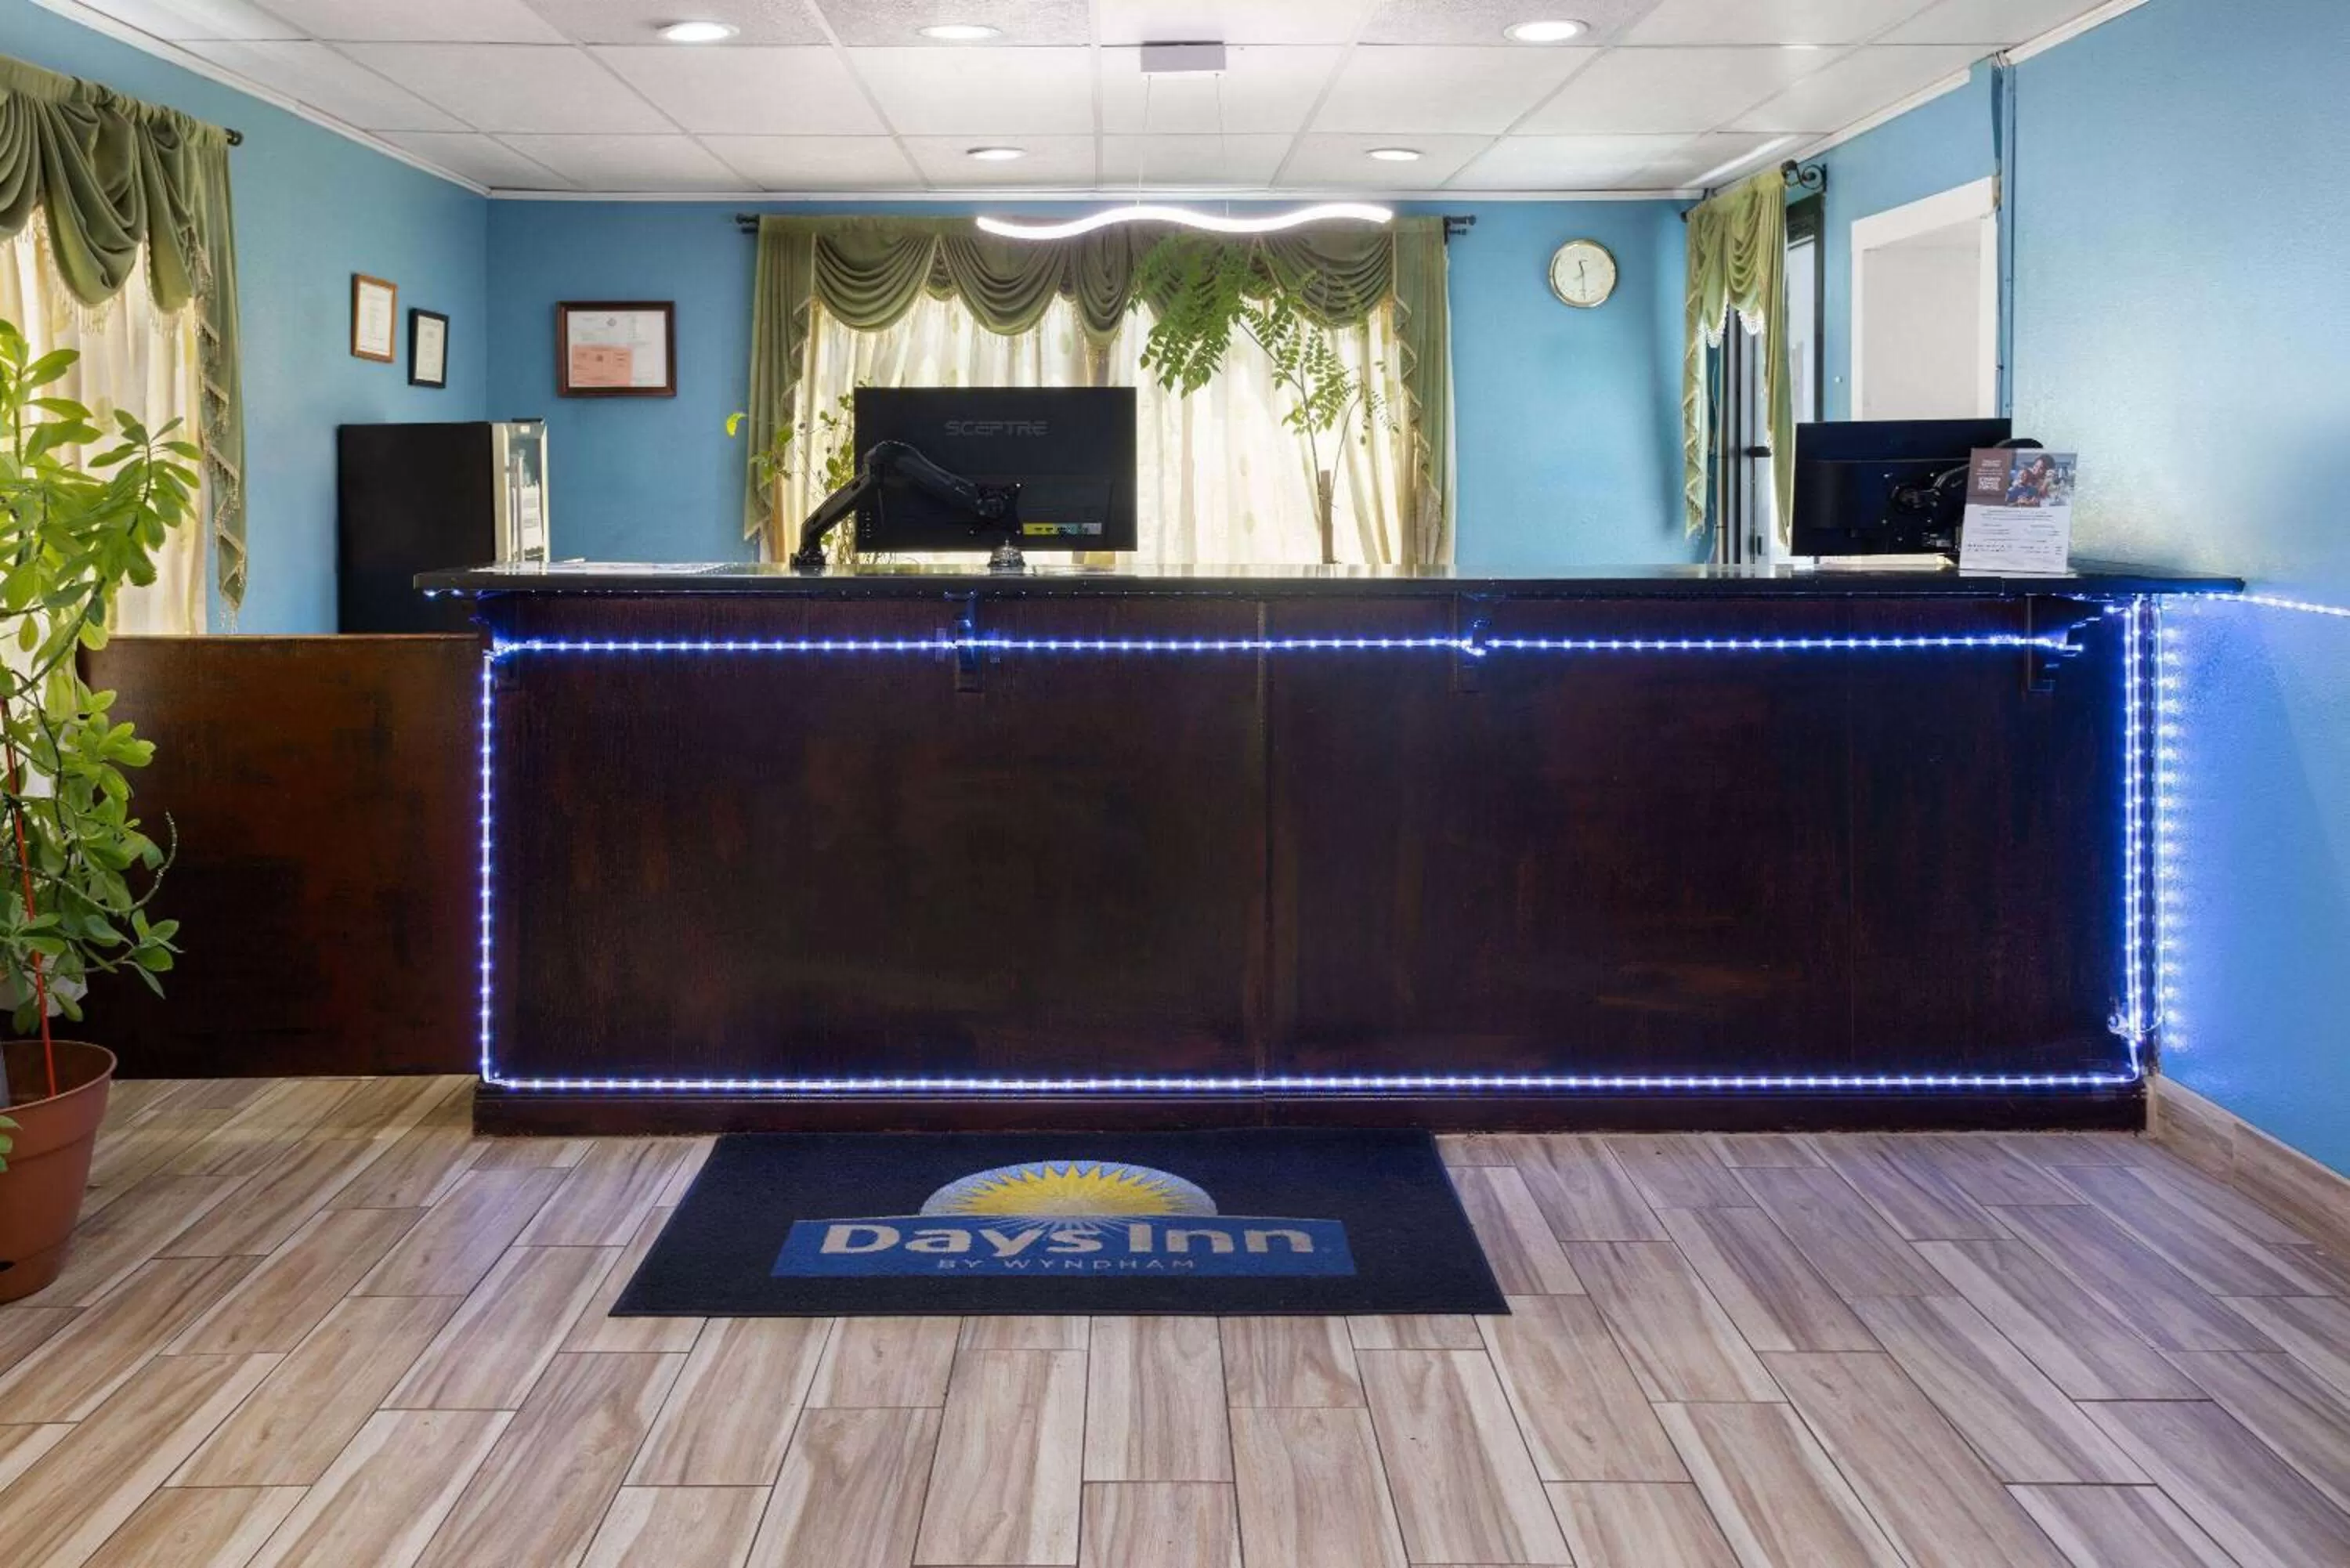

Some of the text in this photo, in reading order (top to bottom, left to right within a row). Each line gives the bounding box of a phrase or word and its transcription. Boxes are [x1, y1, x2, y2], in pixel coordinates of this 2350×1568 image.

[944, 420, 1048, 436] SCEPTRE
[820, 1223, 1314, 1257] Days Inn
[937, 1259, 1195, 1270] BY WYNDHAM
